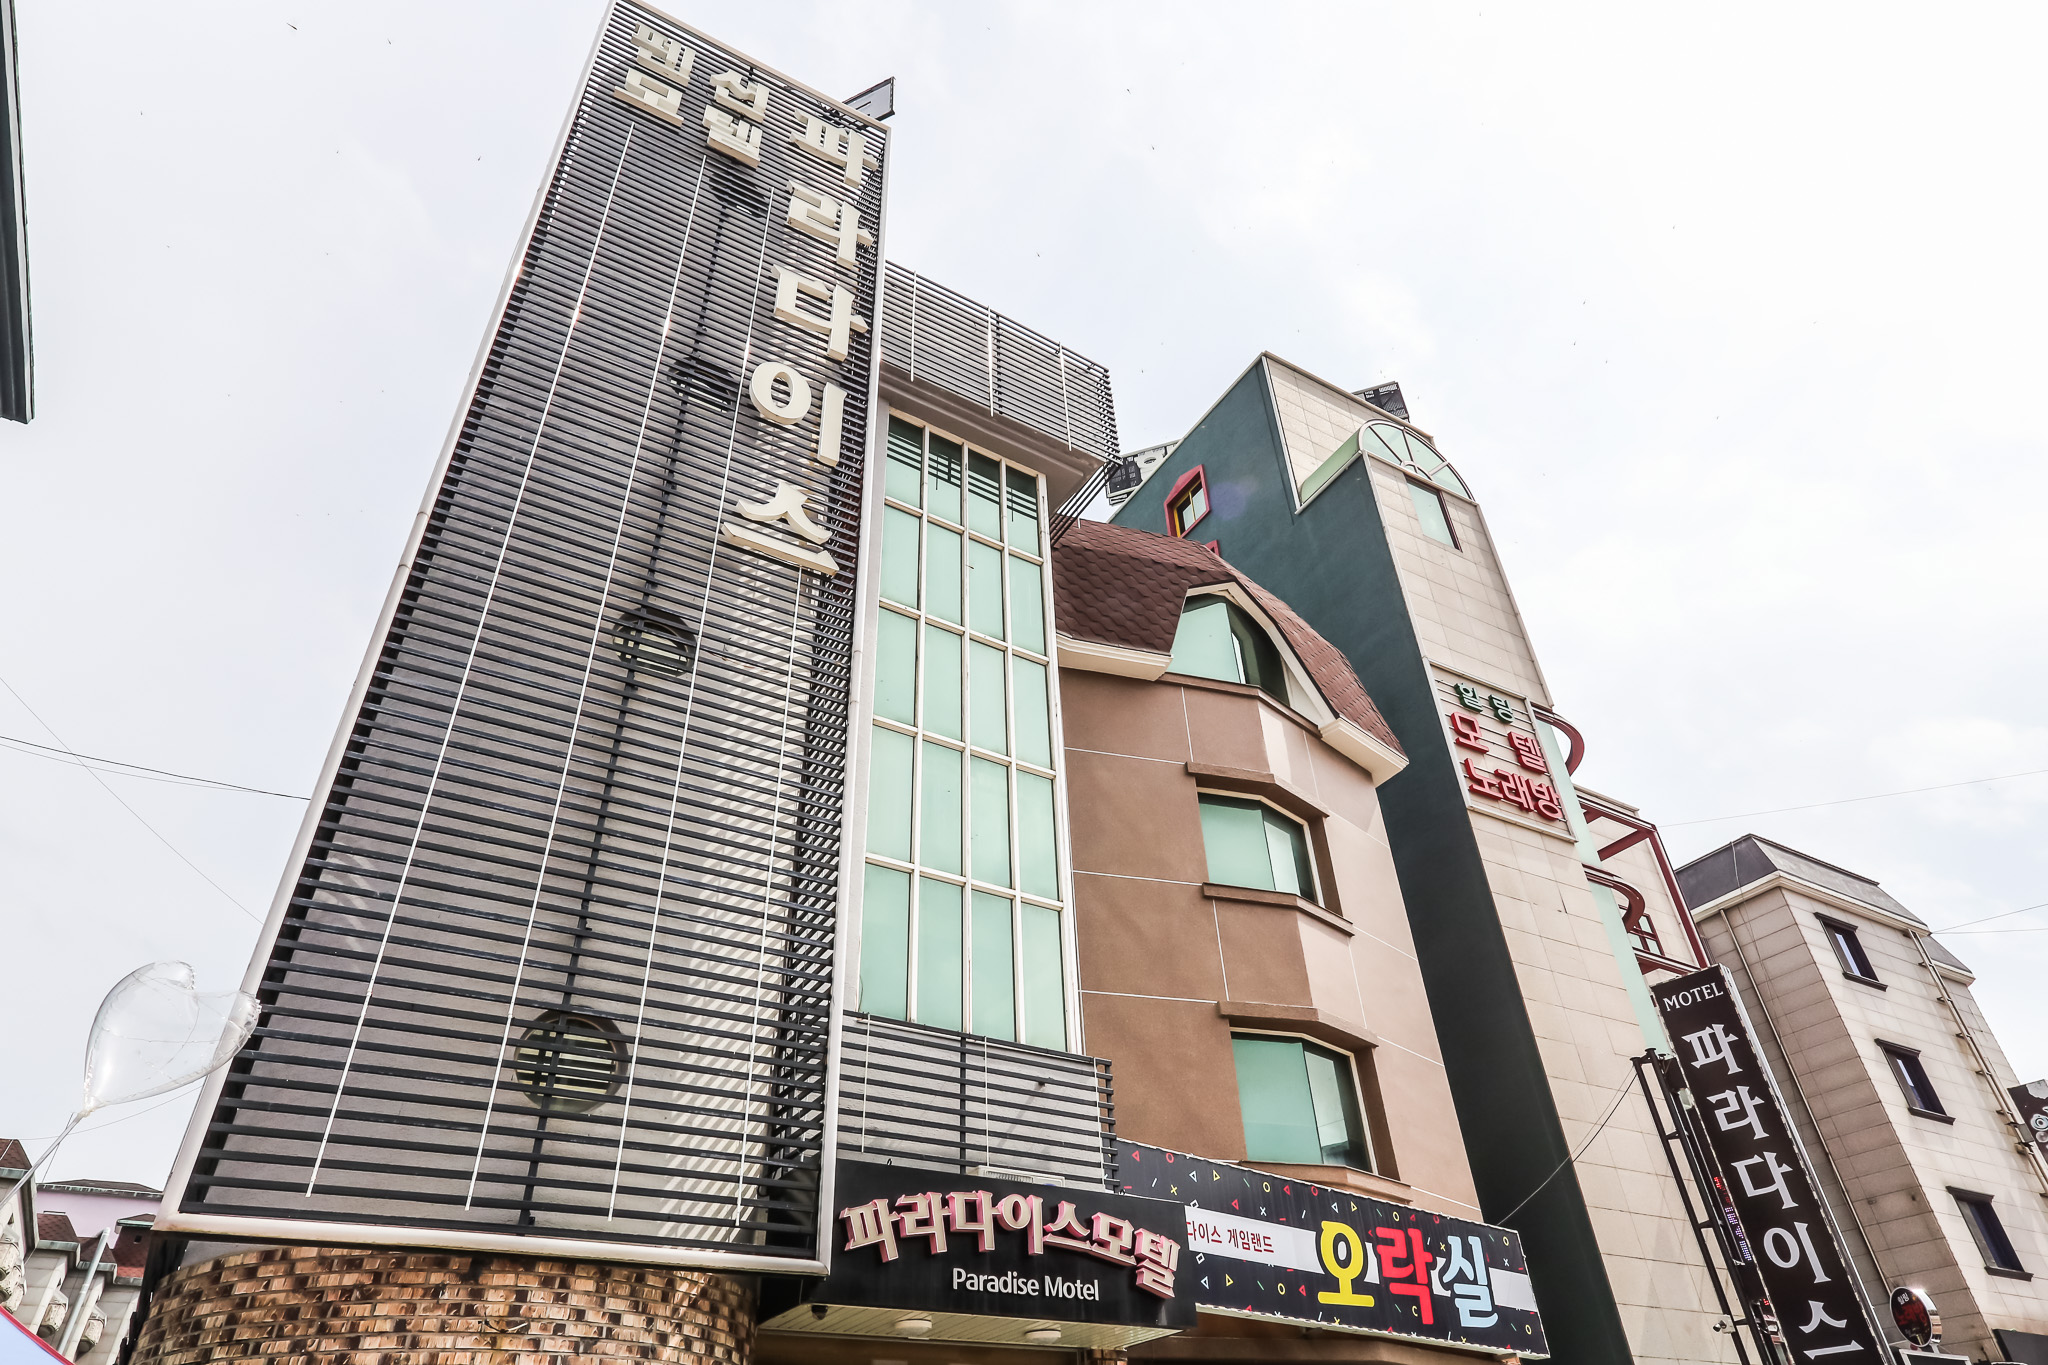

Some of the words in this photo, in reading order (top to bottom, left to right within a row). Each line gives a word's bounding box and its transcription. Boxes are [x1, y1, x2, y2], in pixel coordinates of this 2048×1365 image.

[614, 68, 762, 168] 모텔
[631, 21, 770, 123] 펜션
[721, 109, 879, 576] 파라다이스
[1464, 758, 1563, 821] 노래방
[1663, 982, 1724, 1012] MOTEL
[1227, 1229, 1275, 1253] 게임랜드
[1682, 1023, 1865, 1360] 파라다이스
[839, 1190, 1181, 1299] 파라다이스모텔
[953, 1268, 1039, 1296] Paradise
[1045, 1276, 1099, 1301] Motel
[1317, 1221, 1498, 1328] 오락실
